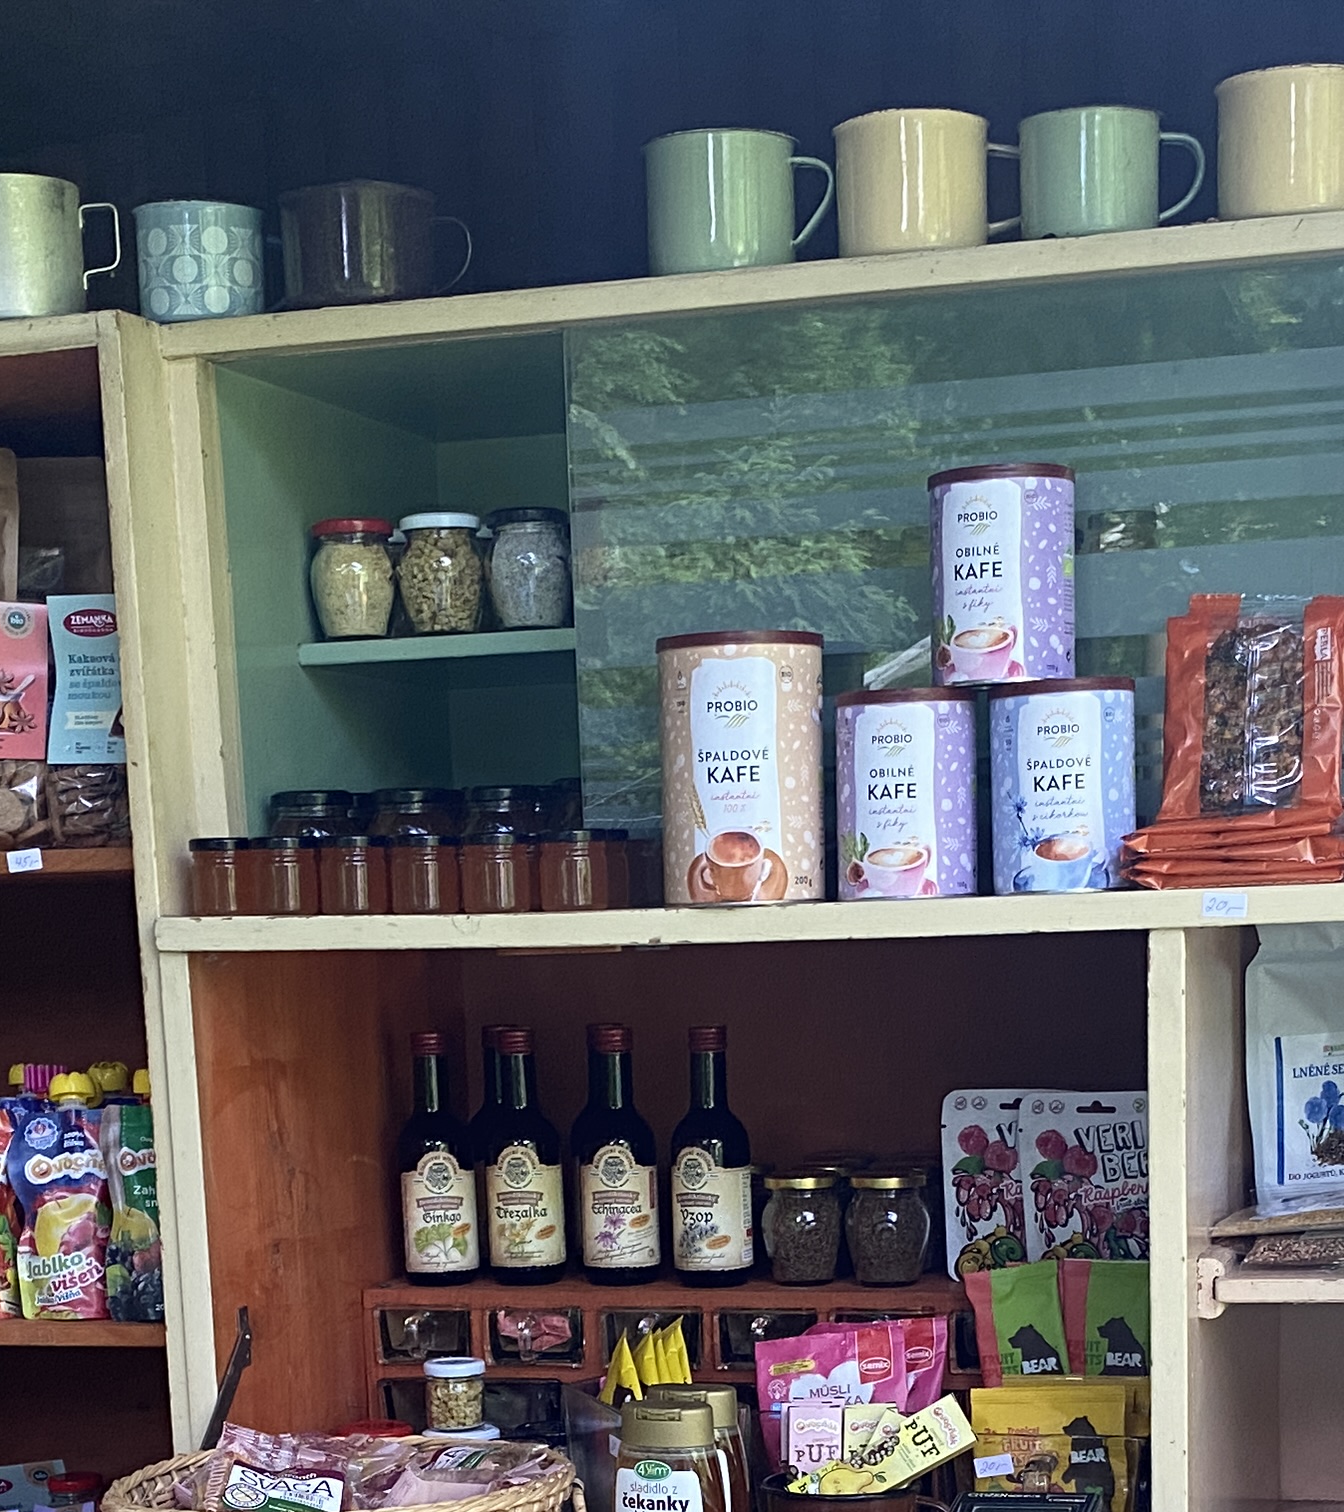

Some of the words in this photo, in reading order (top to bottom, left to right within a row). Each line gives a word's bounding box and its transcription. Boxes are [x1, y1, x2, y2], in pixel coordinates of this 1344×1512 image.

[957, 509, 998, 524] PROBIO
[956, 542, 1000, 559] OBILNÉ
[953, 561, 1003, 581] KAFE
[706, 698, 758, 714] PROBIO
[1036, 723, 1080, 737] PROBIO
[871, 732, 913, 746] PROBIO
[697, 746, 770, 764] ŠPALDOVÉ
[1026, 755, 1092, 770] ŠPALDOVÉ
[706, 765, 760, 783] KAFE
[869, 763, 915, 778] OBILNÉ
[1032, 773, 1086, 792] KAFE
[867, 783, 917, 800] KAFE
[1205, 898, 1244, 914] 20,-
[1293, 1063, 1330, 1078] LNĚNÉ
[494, 1205, 548, 1219] Třezalka
[591, 1201, 642, 1215] Echinacea
[422, 1211, 462, 1224] Ginkgo
[27, 1254, 84, 1278] Jablko
[52, 1257, 104, 1291] višeň
[860, 1360, 889, 1371] semix
[1022, 1357, 1058, 1374] BEAR
[1106, 1353, 1136, 1367] BEAR
[809, 1383, 851, 1399] MÜSLI
[1071, 1449, 1106, 1463] BEAR
[630, 1481, 668, 1494] sladidlo
[672, 1485, 678, 1494] z
